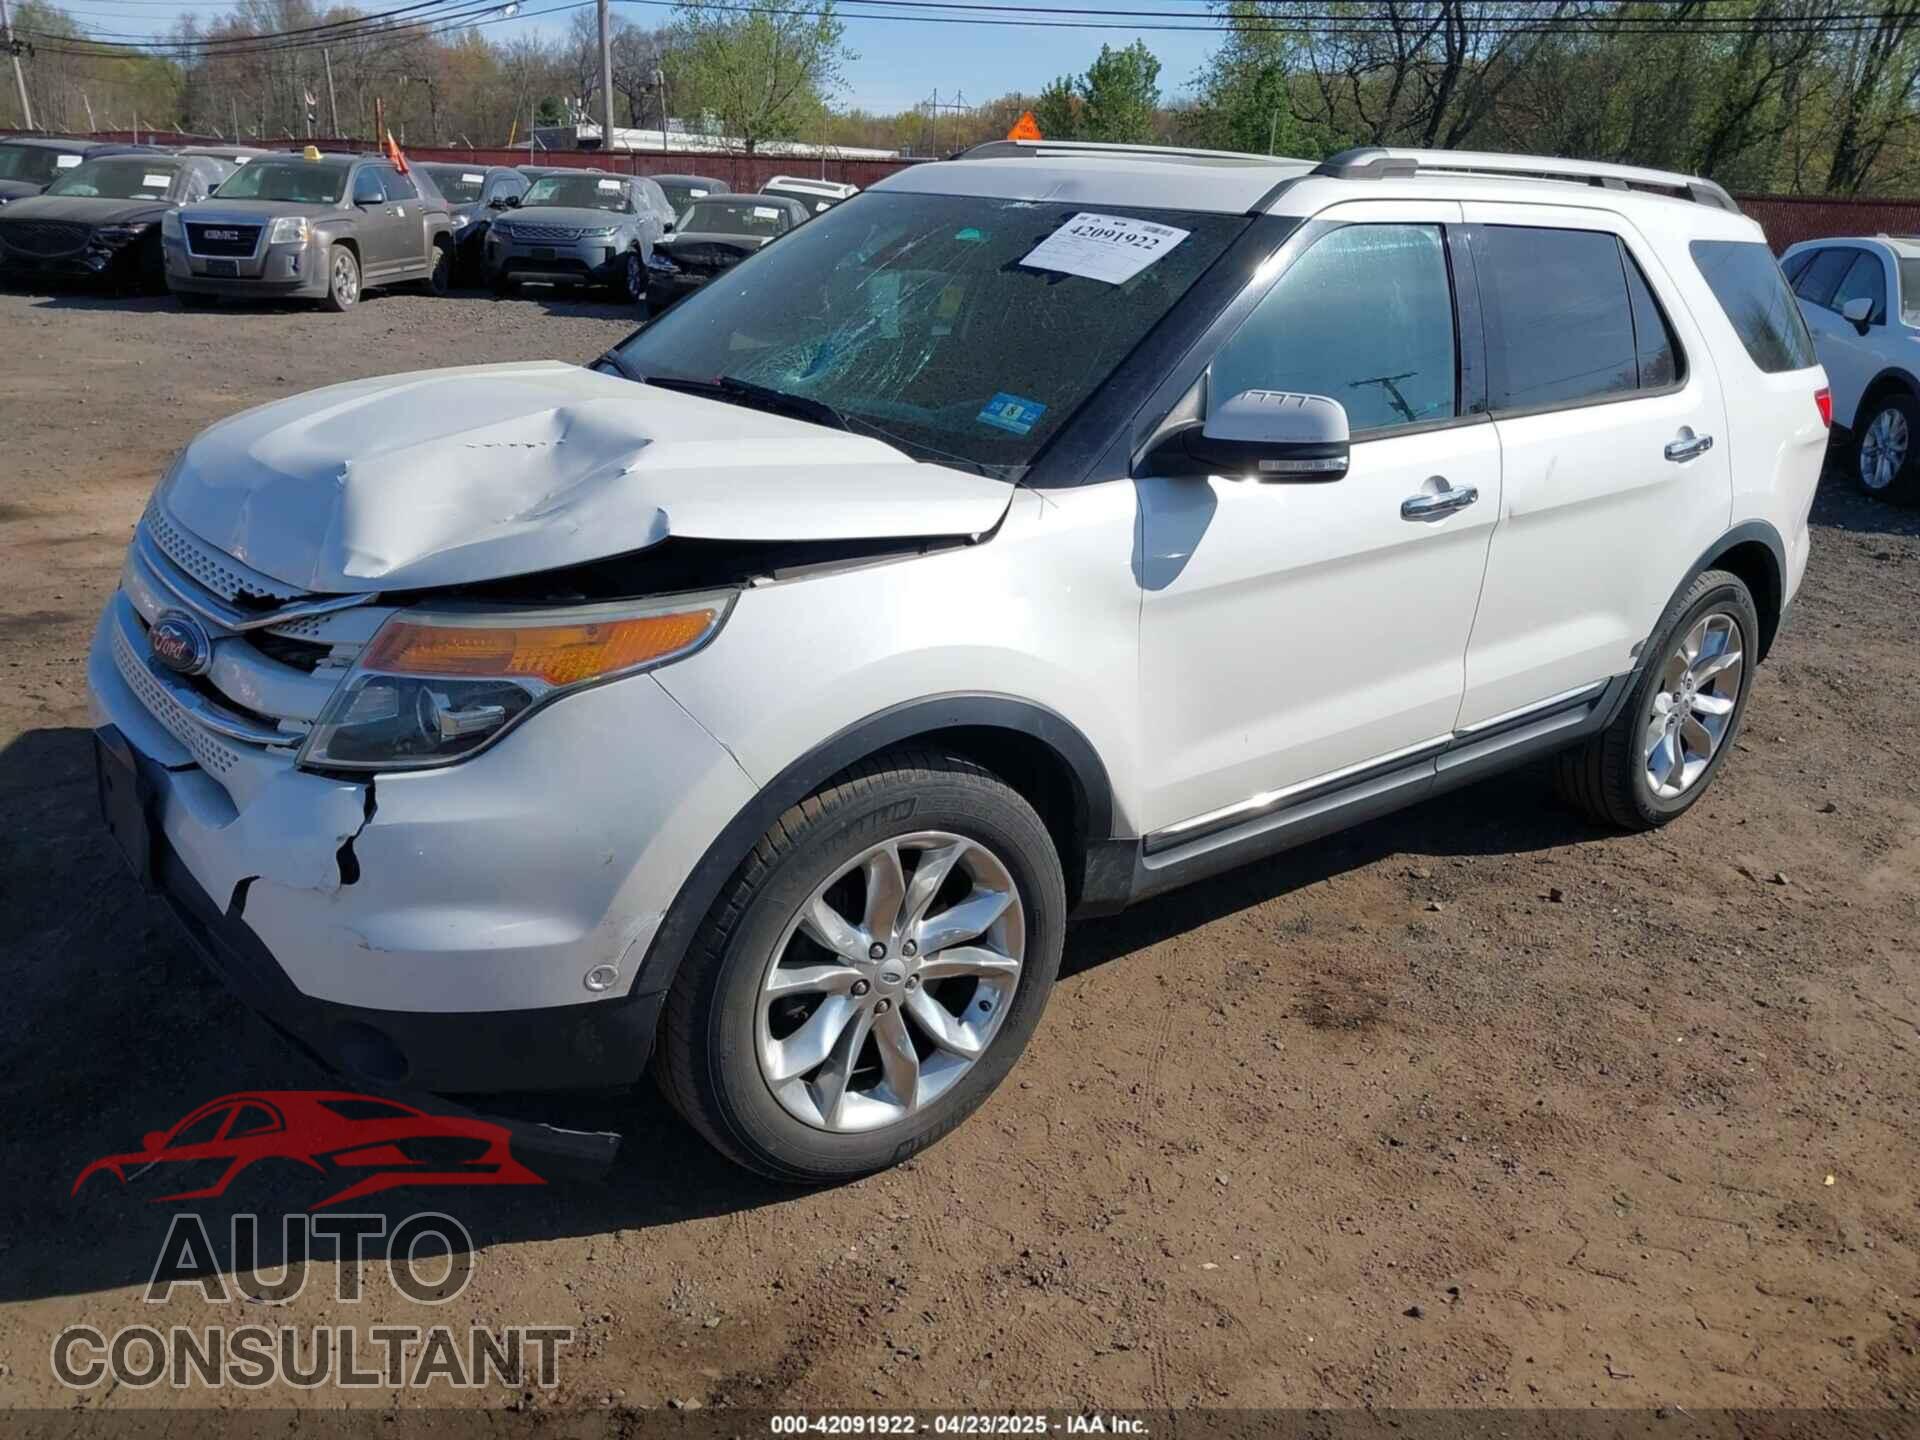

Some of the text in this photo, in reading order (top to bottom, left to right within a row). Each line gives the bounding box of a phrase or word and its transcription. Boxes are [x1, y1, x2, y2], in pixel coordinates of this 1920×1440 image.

[204, 230, 239, 240] GMC
[1070, 225, 1160, 250] 42091922
[153, 625, 187, 659] Ford
